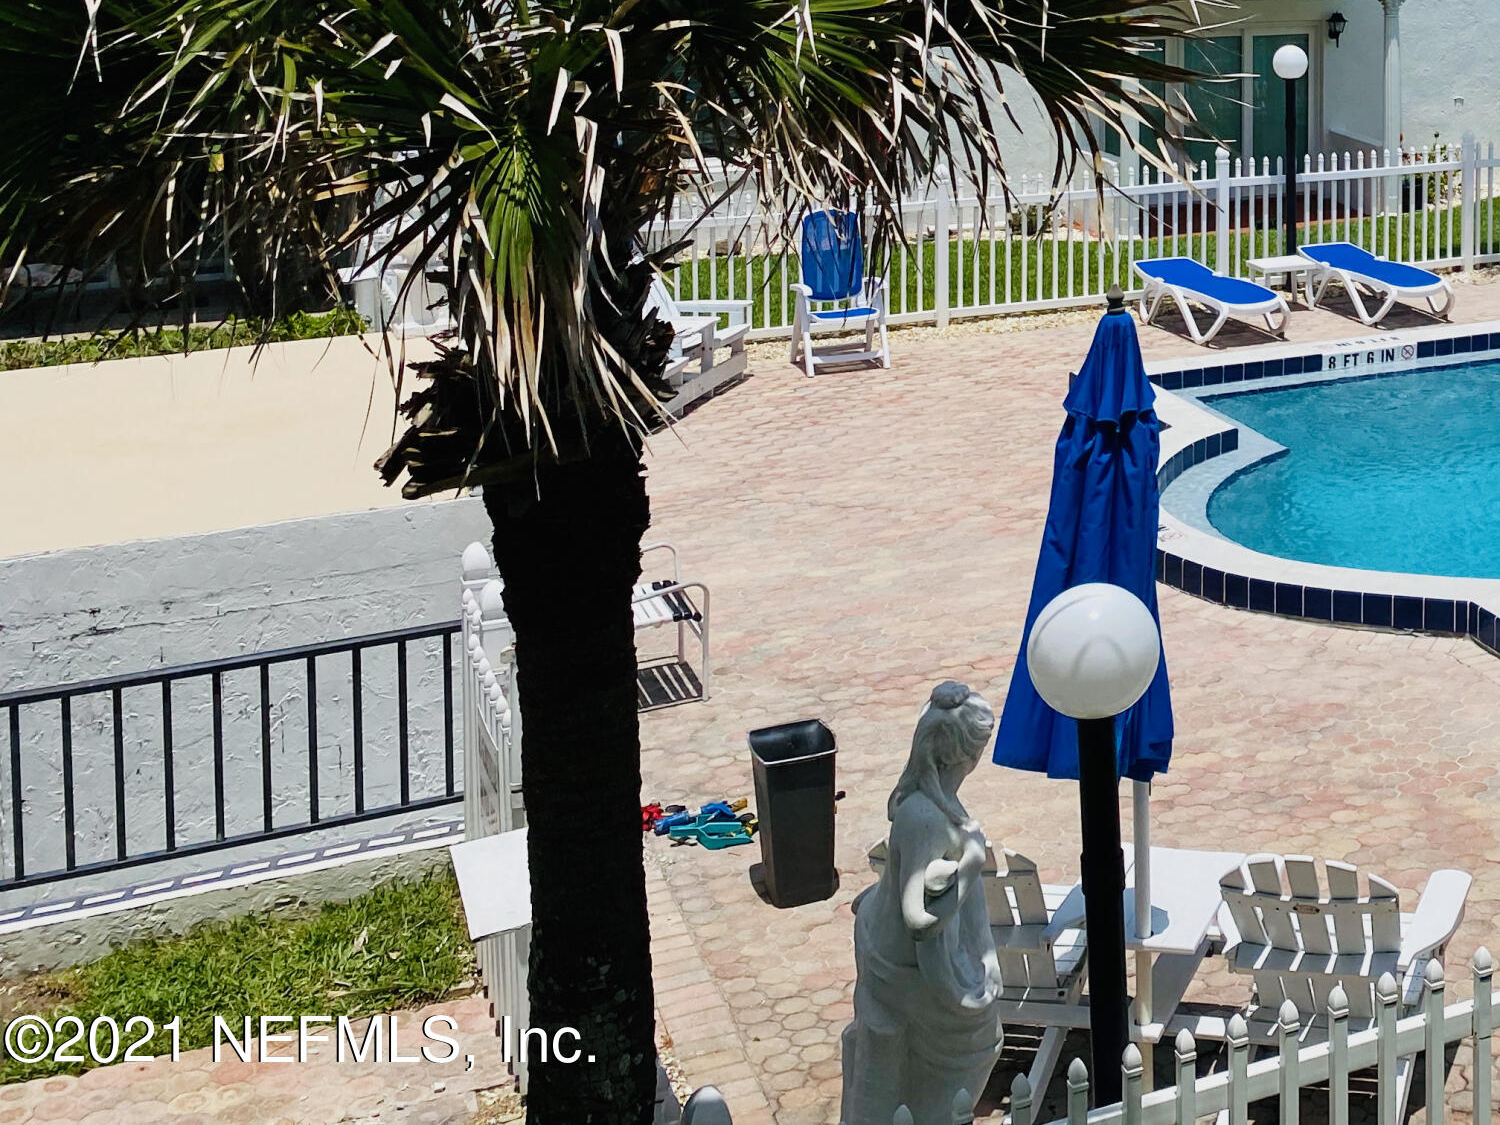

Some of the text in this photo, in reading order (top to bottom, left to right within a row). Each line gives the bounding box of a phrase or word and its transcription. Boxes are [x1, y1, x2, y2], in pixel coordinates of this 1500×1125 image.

[1328, 348, 1395, 369] 8 FT 6 IN
